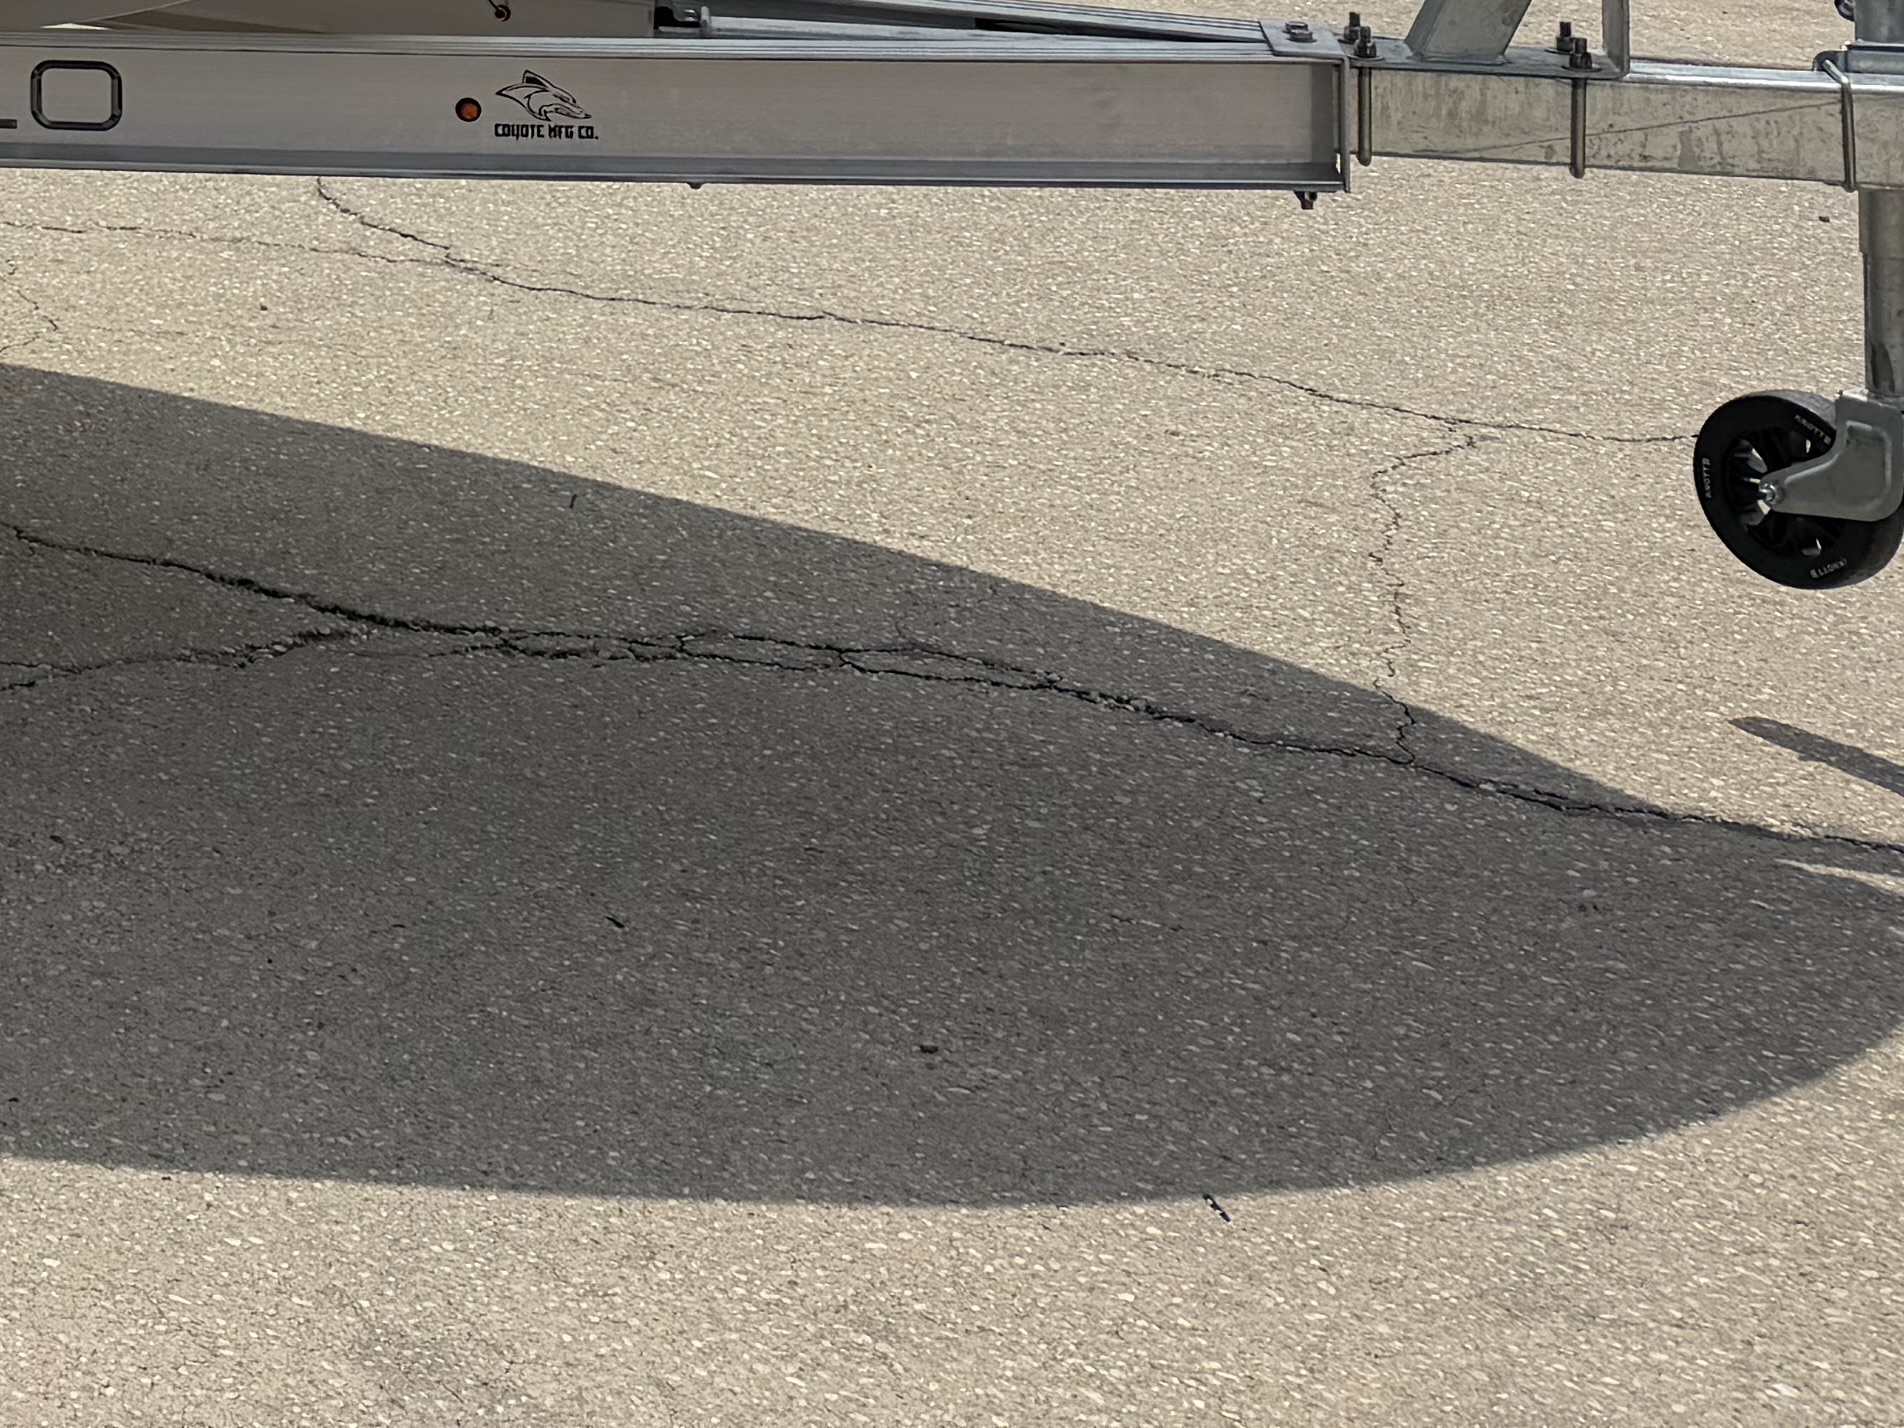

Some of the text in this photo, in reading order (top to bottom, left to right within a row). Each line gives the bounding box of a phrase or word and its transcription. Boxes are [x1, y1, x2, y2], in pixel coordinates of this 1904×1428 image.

[494, 123, 599, 140] COYOTE MFG CO.
